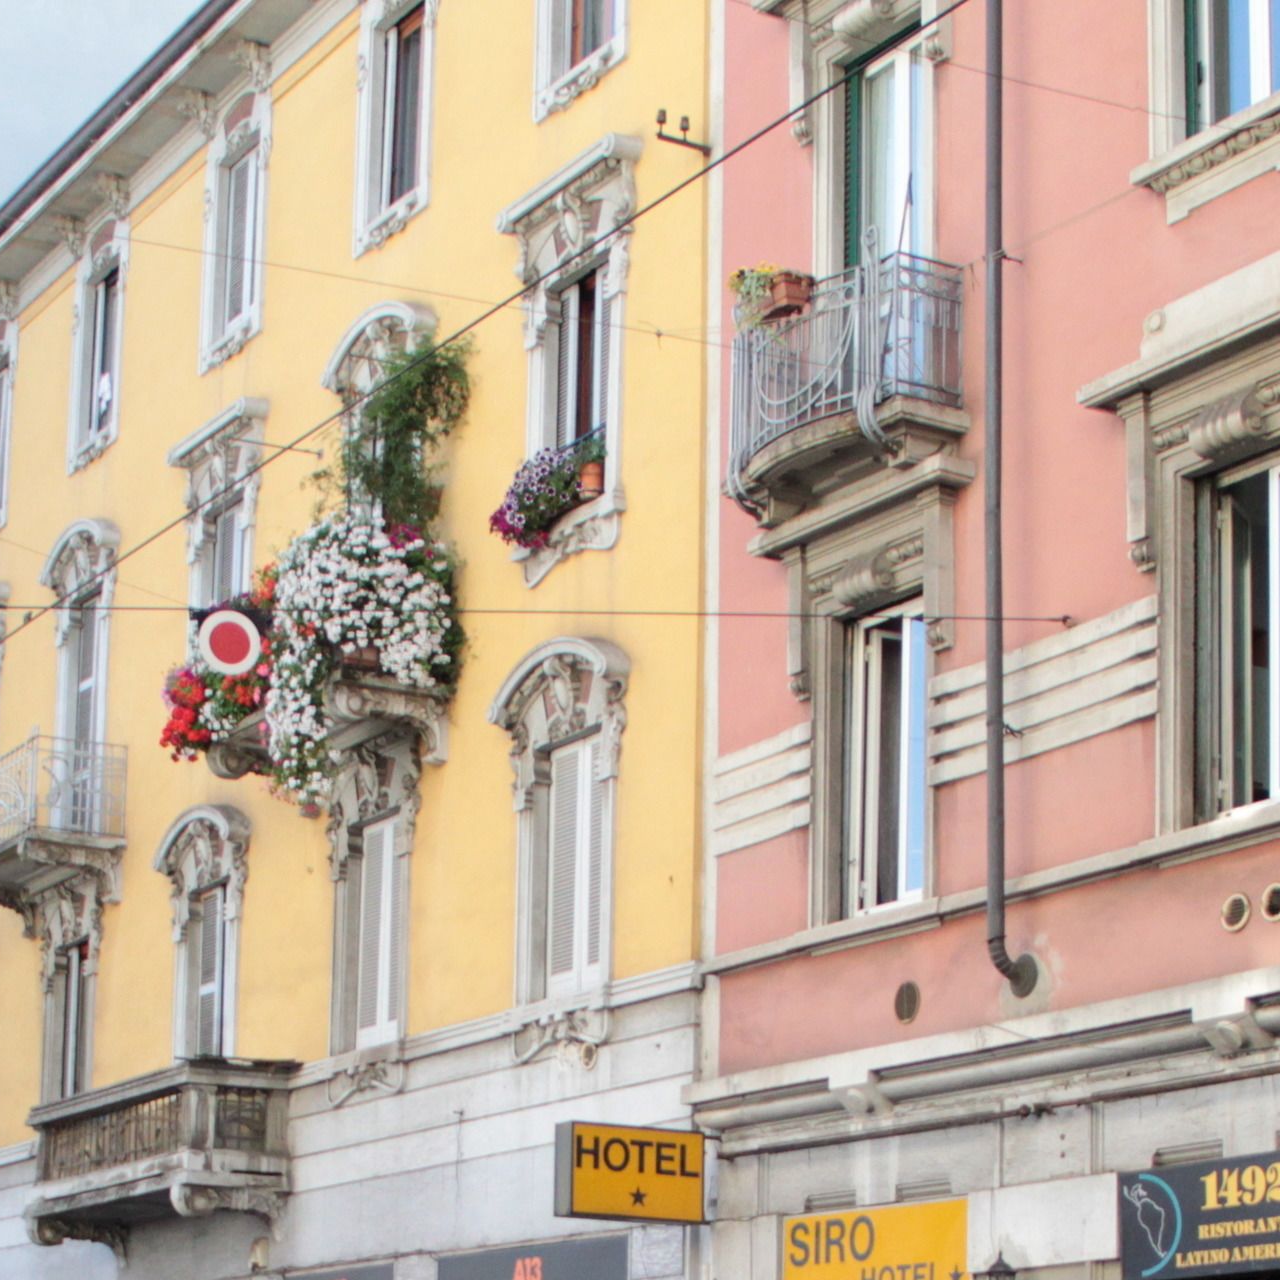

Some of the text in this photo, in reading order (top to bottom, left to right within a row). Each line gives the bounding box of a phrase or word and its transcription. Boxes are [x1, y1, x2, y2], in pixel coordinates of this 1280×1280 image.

[575, 1134, 700, 1178] HOTEL
[789, 1215, 875, 1267] SIRO
[1175, 1248, 1230, 1268] LATINO
